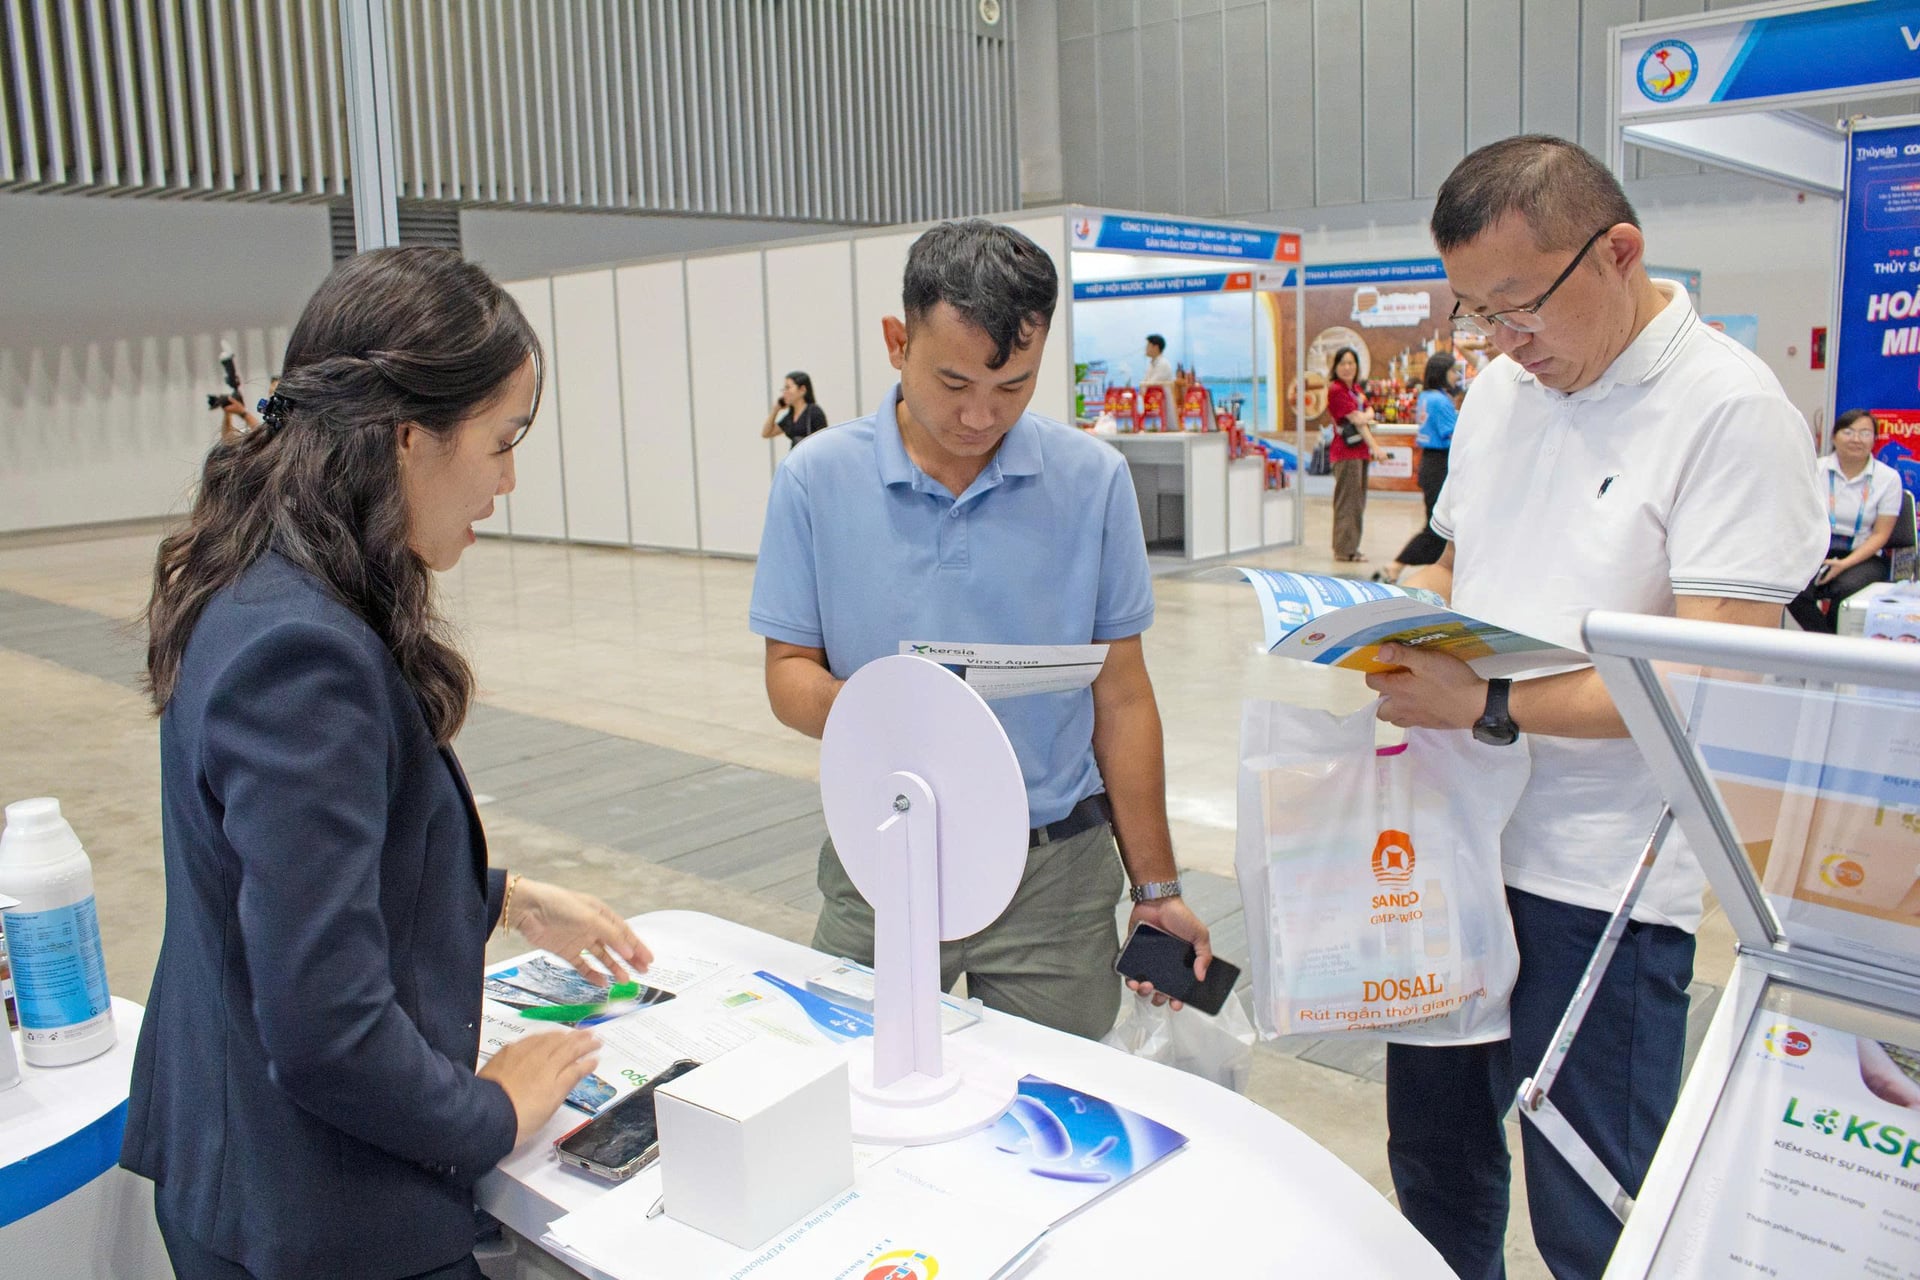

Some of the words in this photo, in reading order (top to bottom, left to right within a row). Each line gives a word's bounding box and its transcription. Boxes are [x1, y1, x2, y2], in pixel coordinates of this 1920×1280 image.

[1873, 260, 1906, 274] THỦY
[929, 647, 975, 656] kersia
[1371, 891, 1420, 909] SANDO
[1362, 973, 1443, 1003] DOSAL
[1300, 1008, 1331, 1021] Rút
[1385, 1003, 1418, 1018] thời
[1422, 998, 1454, 1015] gian
[1773, 1138, 1802, 1154] KIỂM
[1804, 1148, 1836, 1165] SOÁT
[1857, 1165, 1891, 1182] PHÁT
[832, 1191, 861, 1212] Better
[803, 1210, 834, 1230] living
[785, 1226, 807, 1244] with
